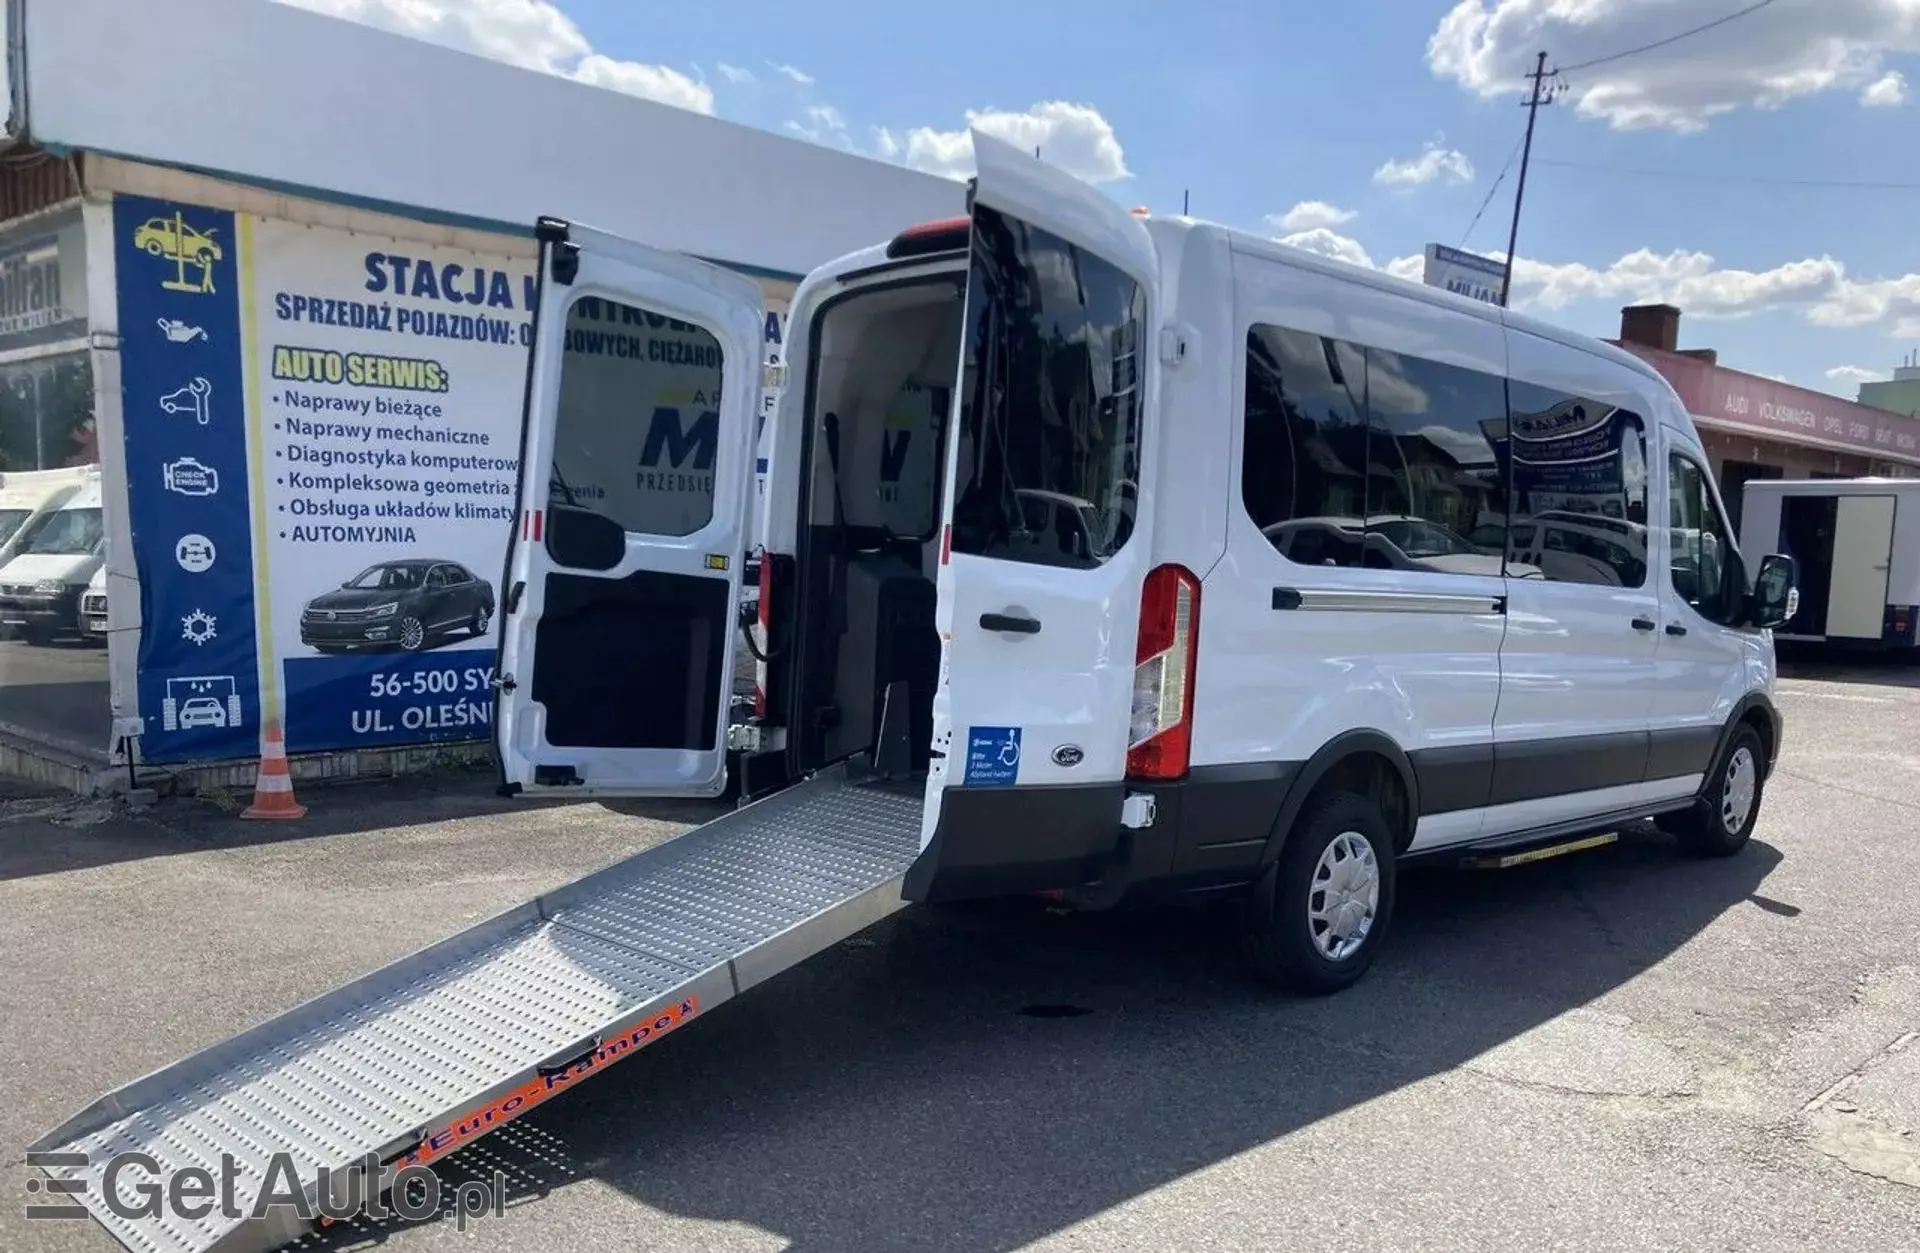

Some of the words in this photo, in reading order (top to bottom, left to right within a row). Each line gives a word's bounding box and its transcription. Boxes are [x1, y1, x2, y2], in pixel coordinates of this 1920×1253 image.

[364, 252, 514, 309] STACJA
[275, 292, 392, 332] SPRZEDAŻ
[397, 307, 515, 345] POJAZDÓW:
[273, 345, 344, 384] AUTO
[346, 351, 449, 393] SERWIS:
[285, 390, 371, 416] Naprawy
[376, 396, 442, 421] bieżące
[286, 417, 372, 441] Naprawy
[376, 425, 490, 446] mechaniczne
[287, 445, 406, 468] Diagnostyka
[289, 472, 420, 494] Kompleksowa
[424, 479, 510, 497] geometria
[290, 499, 370, 521] Obsługa
[375, 500, 450, 519] układów
[292, 526, 417, 543] AUTOMYJNIA
[370, 669, 458, 698] 56-500
[352, 709, 395, 734] UL.
